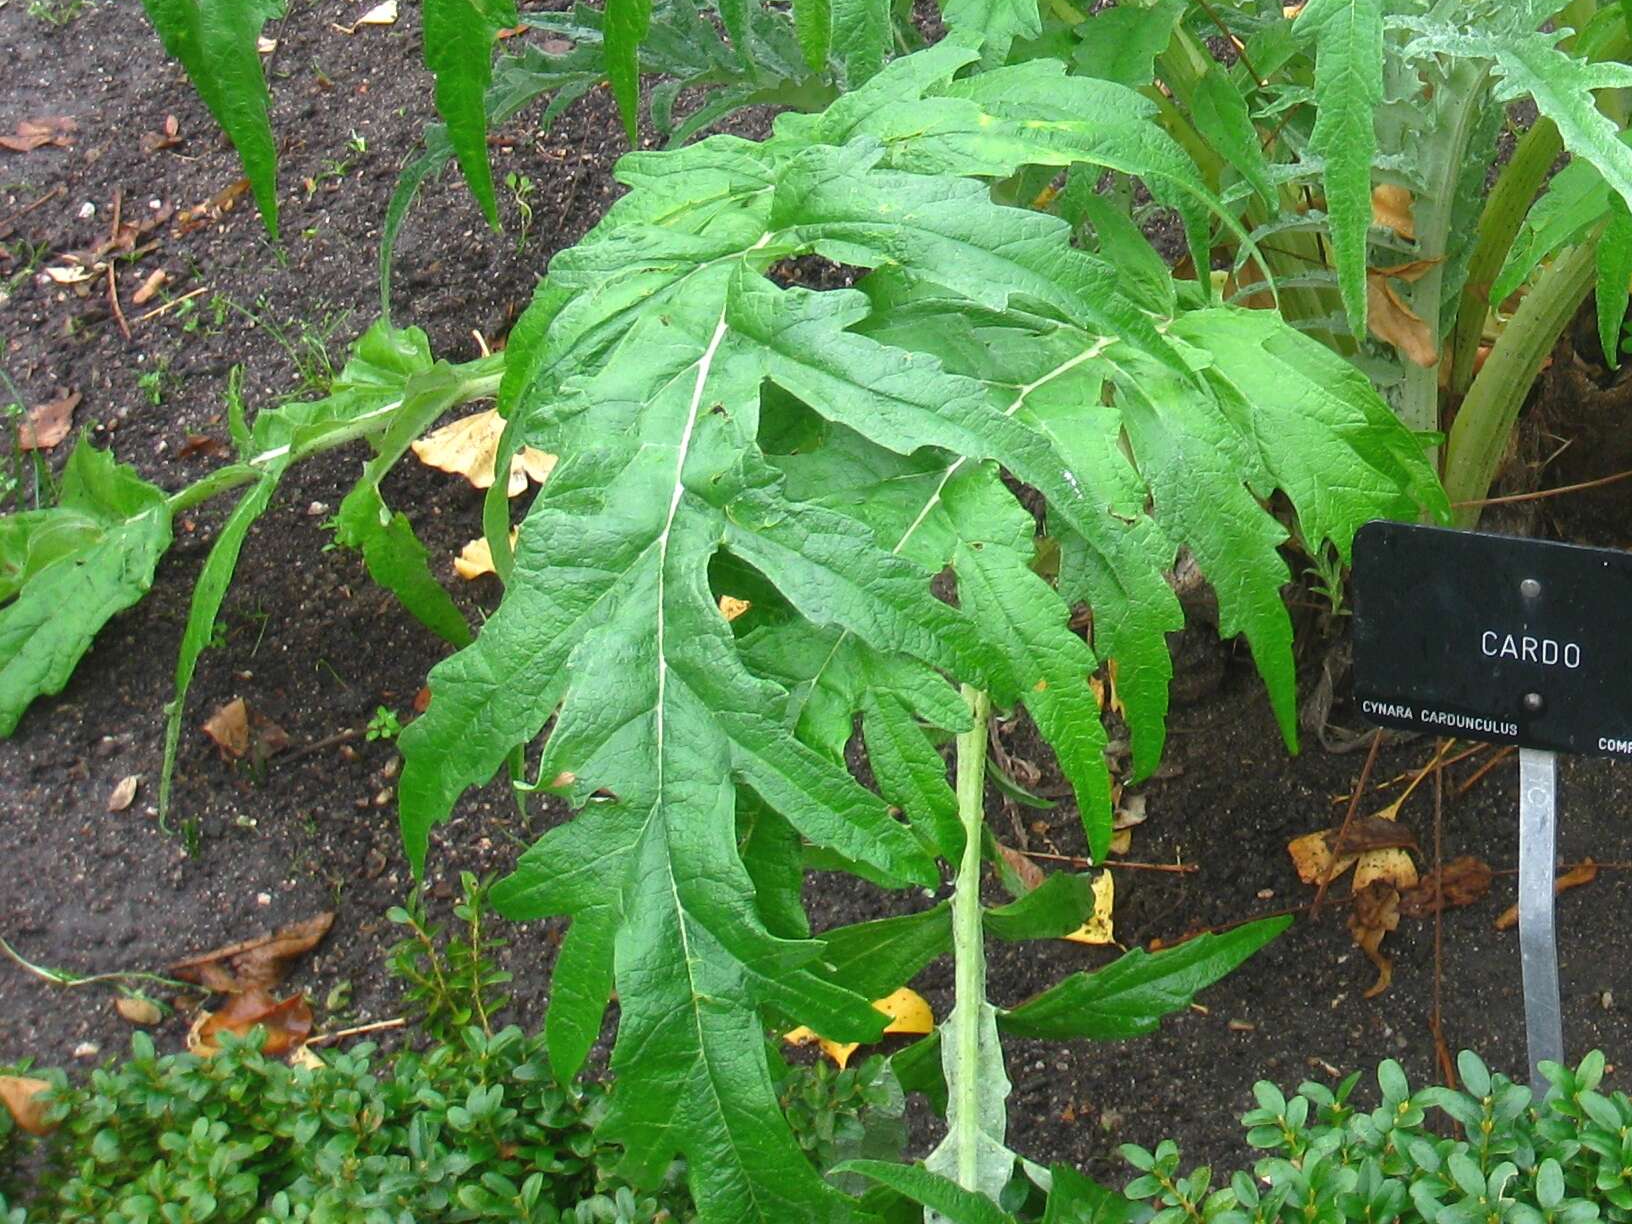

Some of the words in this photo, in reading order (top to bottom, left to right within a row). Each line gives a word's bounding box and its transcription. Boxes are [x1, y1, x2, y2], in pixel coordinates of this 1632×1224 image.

[1481, 630, 1581, 669] CARDO
[1362, 699, 1414, 721] CYNARA
[1420, 709, 1519, 737] CARDUNCULUS
